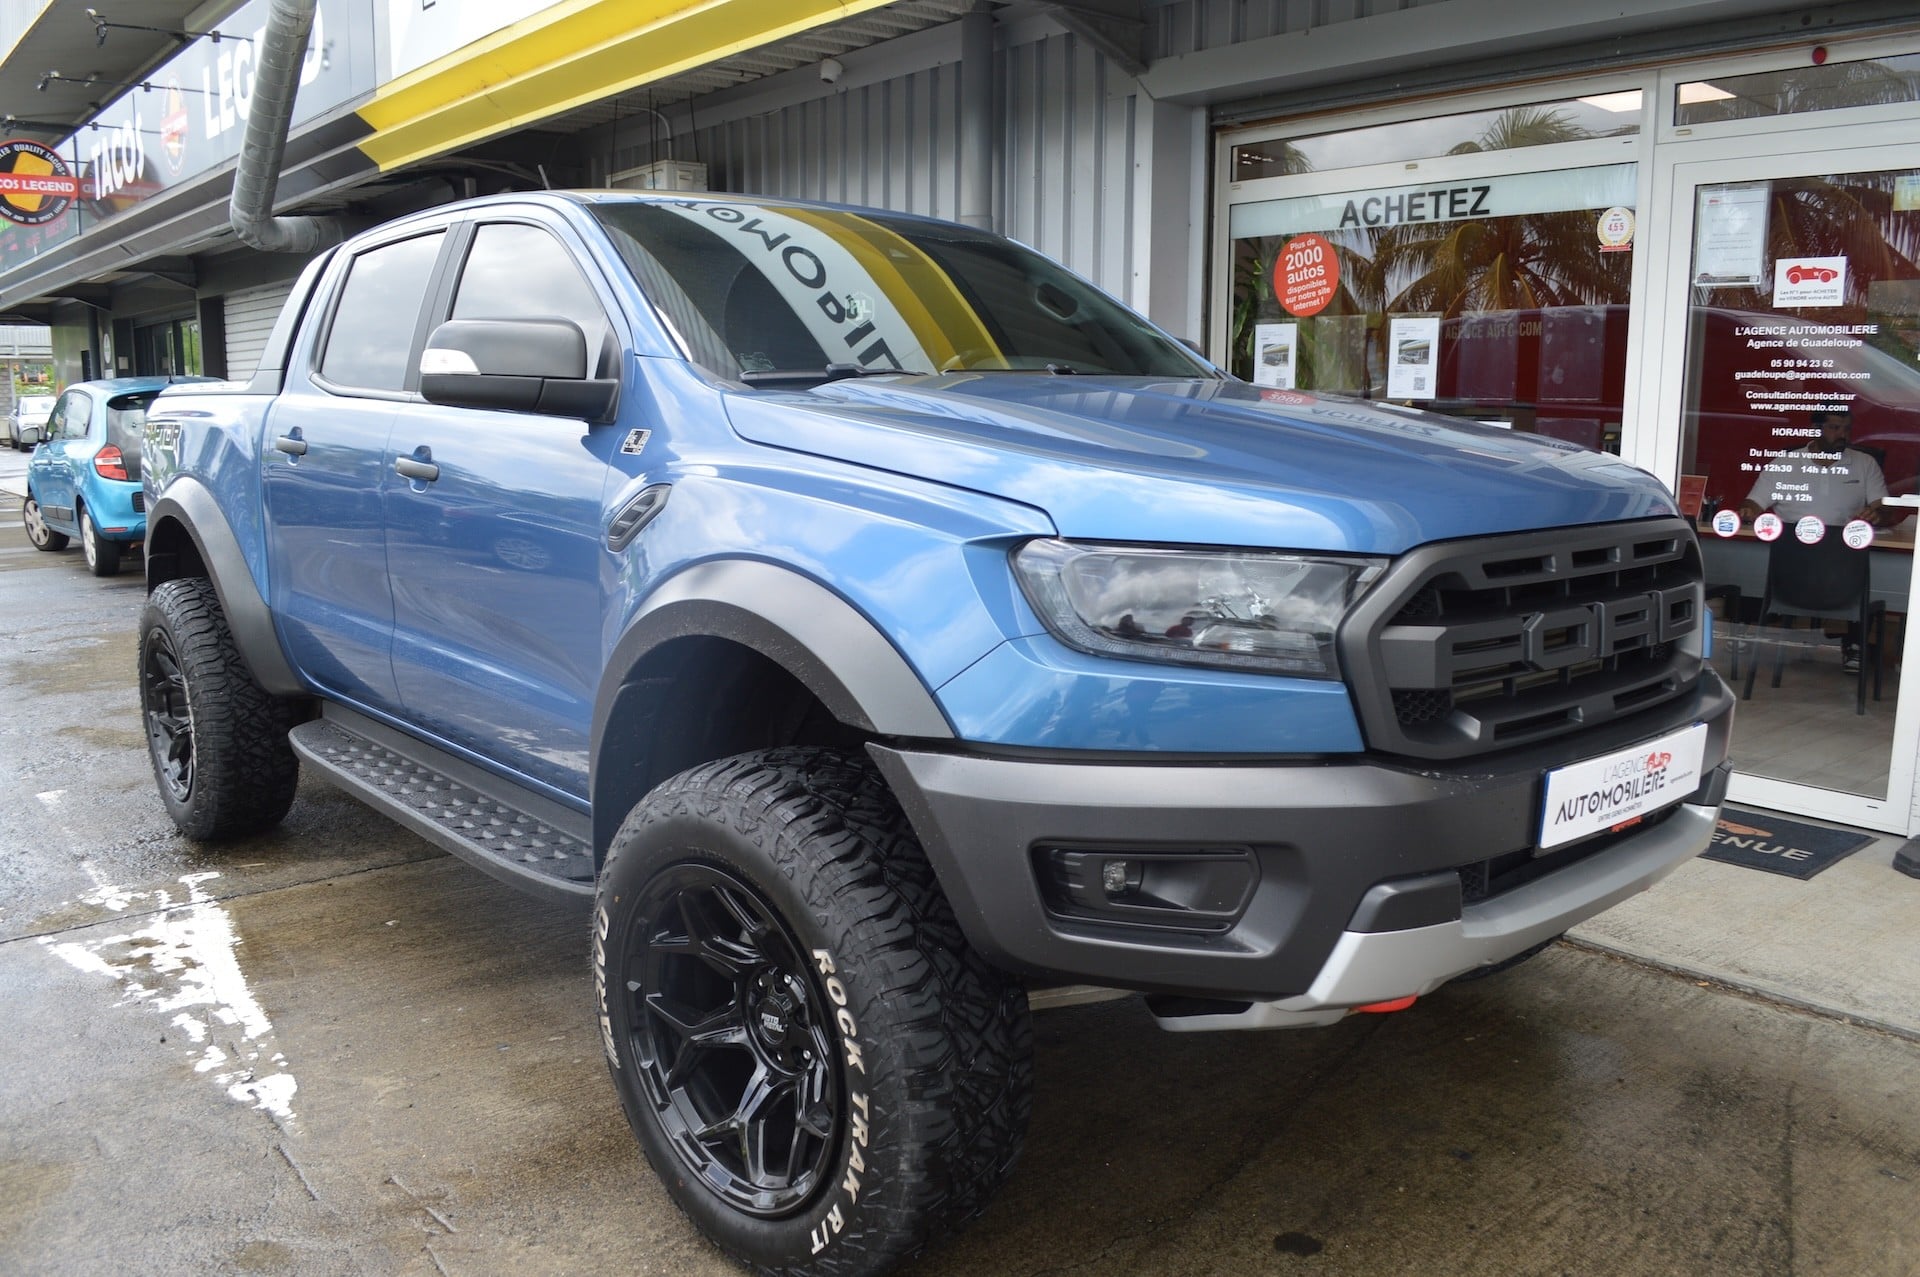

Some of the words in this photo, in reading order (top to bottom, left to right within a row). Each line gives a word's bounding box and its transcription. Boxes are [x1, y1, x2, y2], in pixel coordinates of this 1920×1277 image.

[91, 112, 144, 200] TACOS
[203, 0, 324, 139] LEGD
[14, 143, 46, 156] QUALITY
[45, 151, 66, 173] TACOS
[22, 180, 75, 192] LEGEND
[1339, 185, 1490, 228] ACHETEZ
[1290, 240, 1306, 251] Plus
[1307, 238, 1316, 246] de
[1285, 246, 1323, 271] 2000
[1287, 265, 1325, 284] autos
[1287, 279, 1327, 295] disponibles
[1285, 296, 1297, 304] sur
[1298, 291, 1316, 300] notre
[1317, 286, 1331, 296] site
[1293, 298, 1320, 311] internet
[1735, 326, 1787, 336] L'AGENCE
[1788, 325, 1878, 336] AUTOMOBILIERE
[1747, 339, 1784, 349] Agence
[1786, 338, 1798, 347] de
[1801, 338, 1863, 349] Guadeloupe
[1771, 359, 1782, 367] 05
[1783, 359, 1795, 367] 90
[1796, 359, 1807, 367] 94
[1809, 359, 1820, 367] 23
[1822, 359, 1834, 367] 62
[1735, 370, 1871, 380] guadeloupe@agenceauto.com
[1750, 403, 1848, 412] www.agenceauto.com
[1772, 428, 1821, 437] HORAIRES
[1749, 448, 1762, 457] Du
[1764, 449, 1786, 458] lundi
[1801, 452, 1841, 460] vendredi
[1741, 463, 1752, 471] 9h
[1763, 464, 1792, 472] 12h30
[1801, 465, 1818, 474] 14h
[1821, 466, 1828, 474] à
[1830, 467, 1849, 475] 17h
[1775, 482, 1808, 491] Samedi
[1771, 492, 1783, 500] 9h
[1785, 493, 1792, 501] à
[1794, 493, 1812, 501] 12h
[1380, 581, 1698, 690] FORD
[812, 948, 865, 1075] ROCK
[842, 1090, 869, 1205] TRAK
[811, 1202, 845, 1255] R/T
